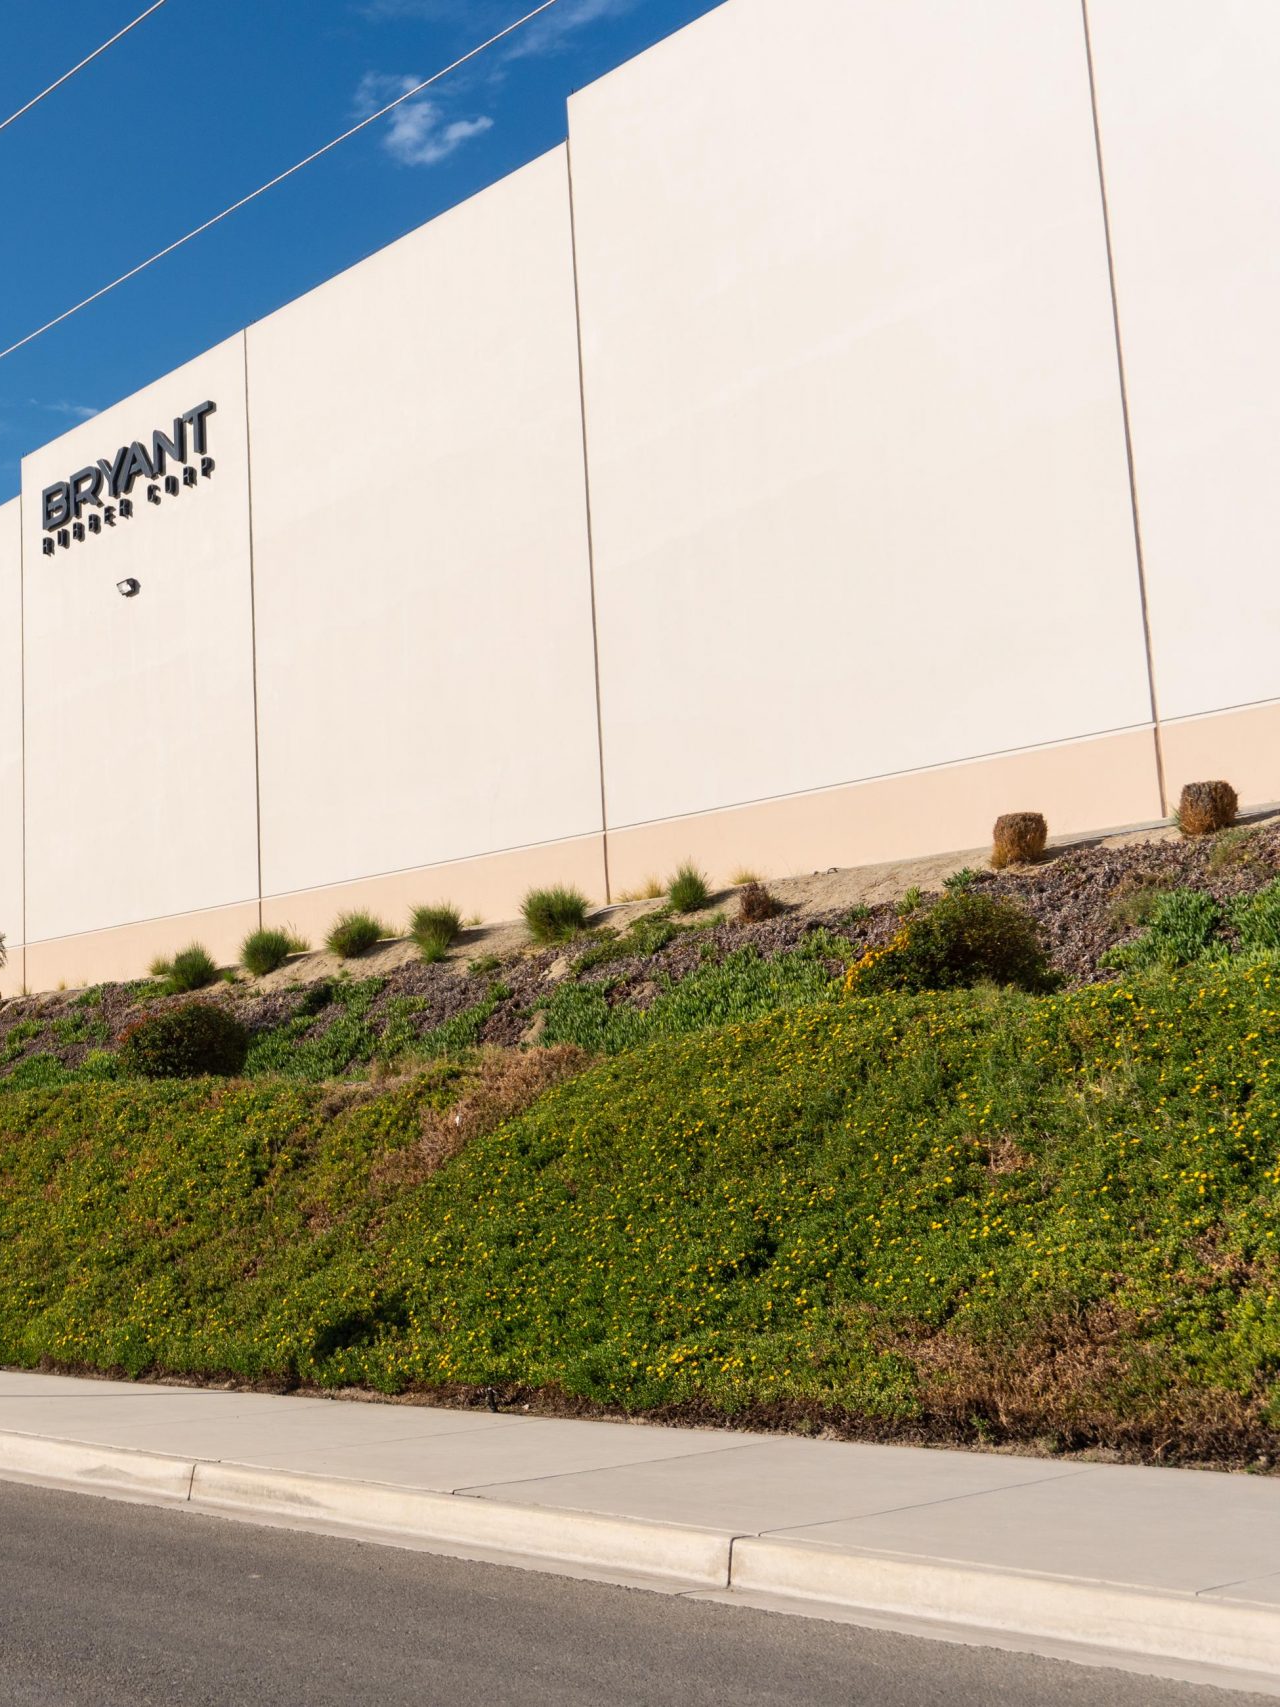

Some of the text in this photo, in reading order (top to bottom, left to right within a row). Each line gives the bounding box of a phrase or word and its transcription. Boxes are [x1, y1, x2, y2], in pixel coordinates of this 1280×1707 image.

[42, 400, 217, 532] BRYANT
[42, 457, 216, 557] RUBBER CORP
